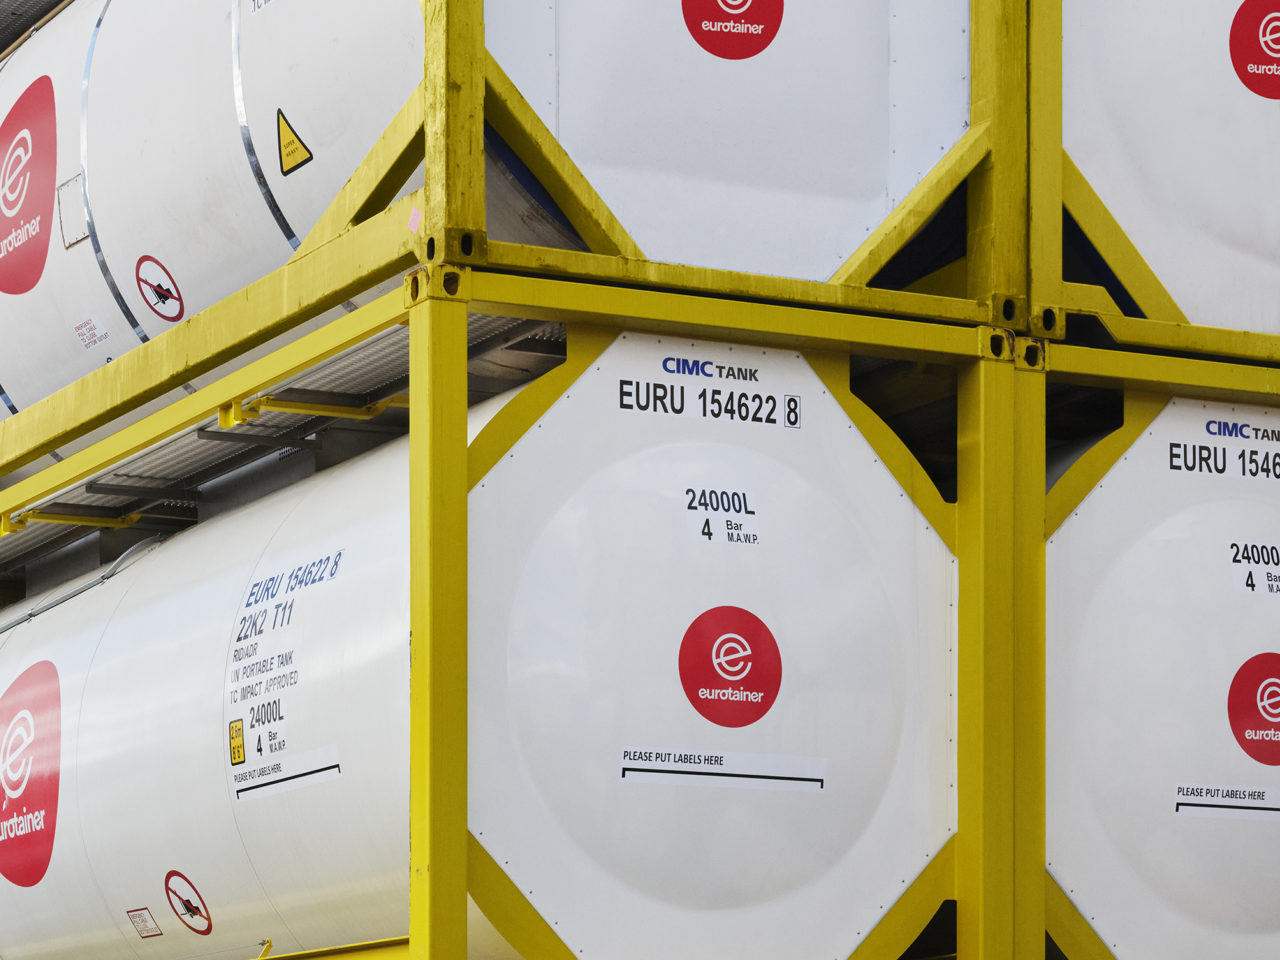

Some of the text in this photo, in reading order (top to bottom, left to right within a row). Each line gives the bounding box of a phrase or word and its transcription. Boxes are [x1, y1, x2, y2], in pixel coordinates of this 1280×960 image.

[701, 19, 764, 34] eurotainer
[662, 357, 759, 382] CIMC TANK
[620, 379, 798, 426] EURU 154622 8
[1205, 420, 1251, 439] CIMC
[1170, 442, 1280, 479] EURU 1546
[685, 488, 756, 516] 24000L
[701, 518, 743, 541] 4 Bar
[727, 532, 760, 545] M.A.W.P.
[1230, 543, 1280, 566] 24000
[245, 551, 342, 608] EURU 154622 8
[1245, 571, 1280, 592] 4 Ba
[236, 598, 295, 643] 22K2 T11
[242, 657, 274, 679] PORTABLE
[277, 650, 294, 669] TANK
[230, 670, 299, 705] TC IMPACT APPROVED
[698, 686, 764, 703] eurotainer
[249, 698, 284, 729] 24000L
[256, 731, 278, 757] 4 Bar
[623, 750, 724, 766] PLEASE PUT LABELS HERE
[234, 762, 282, 784] PLEASE PUT LABELS HERE
[1177, 786, 1266, 801] PLEASE PUT LABELS HERE
